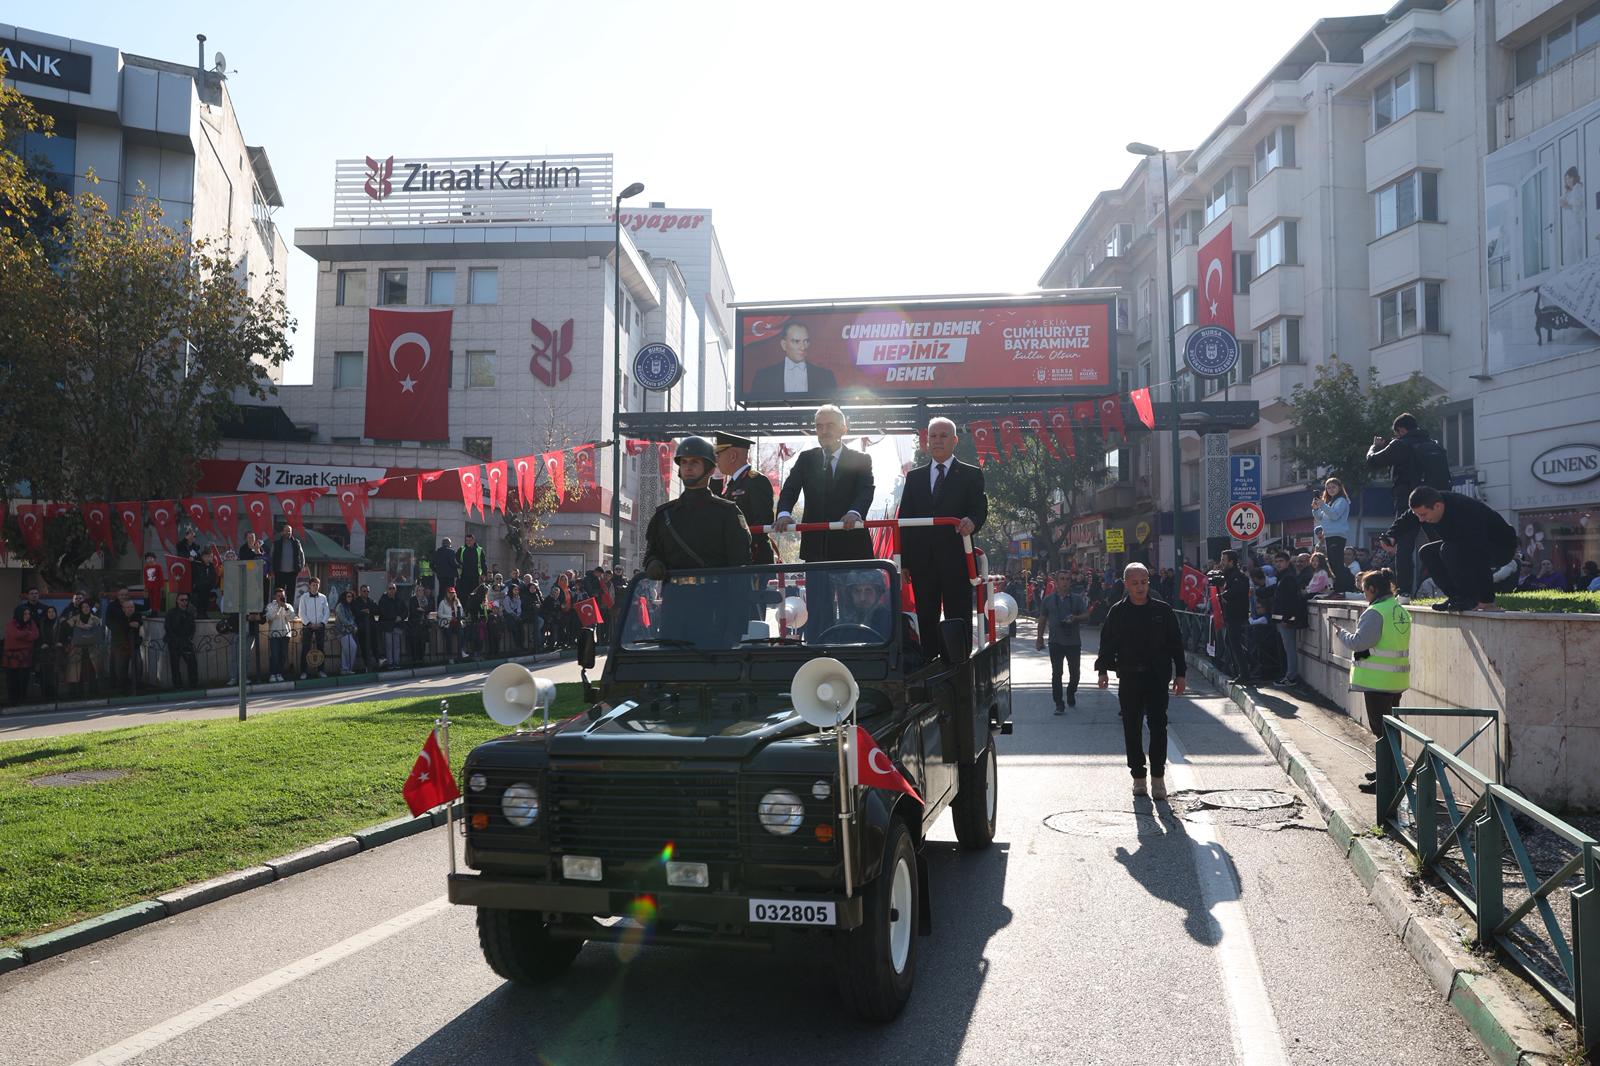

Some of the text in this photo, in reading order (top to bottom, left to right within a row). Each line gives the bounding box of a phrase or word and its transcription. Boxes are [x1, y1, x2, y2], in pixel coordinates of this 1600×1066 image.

[402, 160, 580, 192] Ziraat Katılım
[841, 319, 982, 339] CUMHURİYET DEMEK
[1003, 325, 1091, 339] CUMHURİYET
[872, 340, 951, 361] HEPİMİZ
[1004, 337, 1090, 351] BAYRAMIMIZ
[1048, 350, 1081, 361] Olsun
[886, 366, 937, 382] DEMEK
[1240, 458, 1255, 478] P
[1542, 455, 1598, 475] LINENS
[275, 470, 319, 486] Ziraat
[755, 904, 828, 922] 032805
